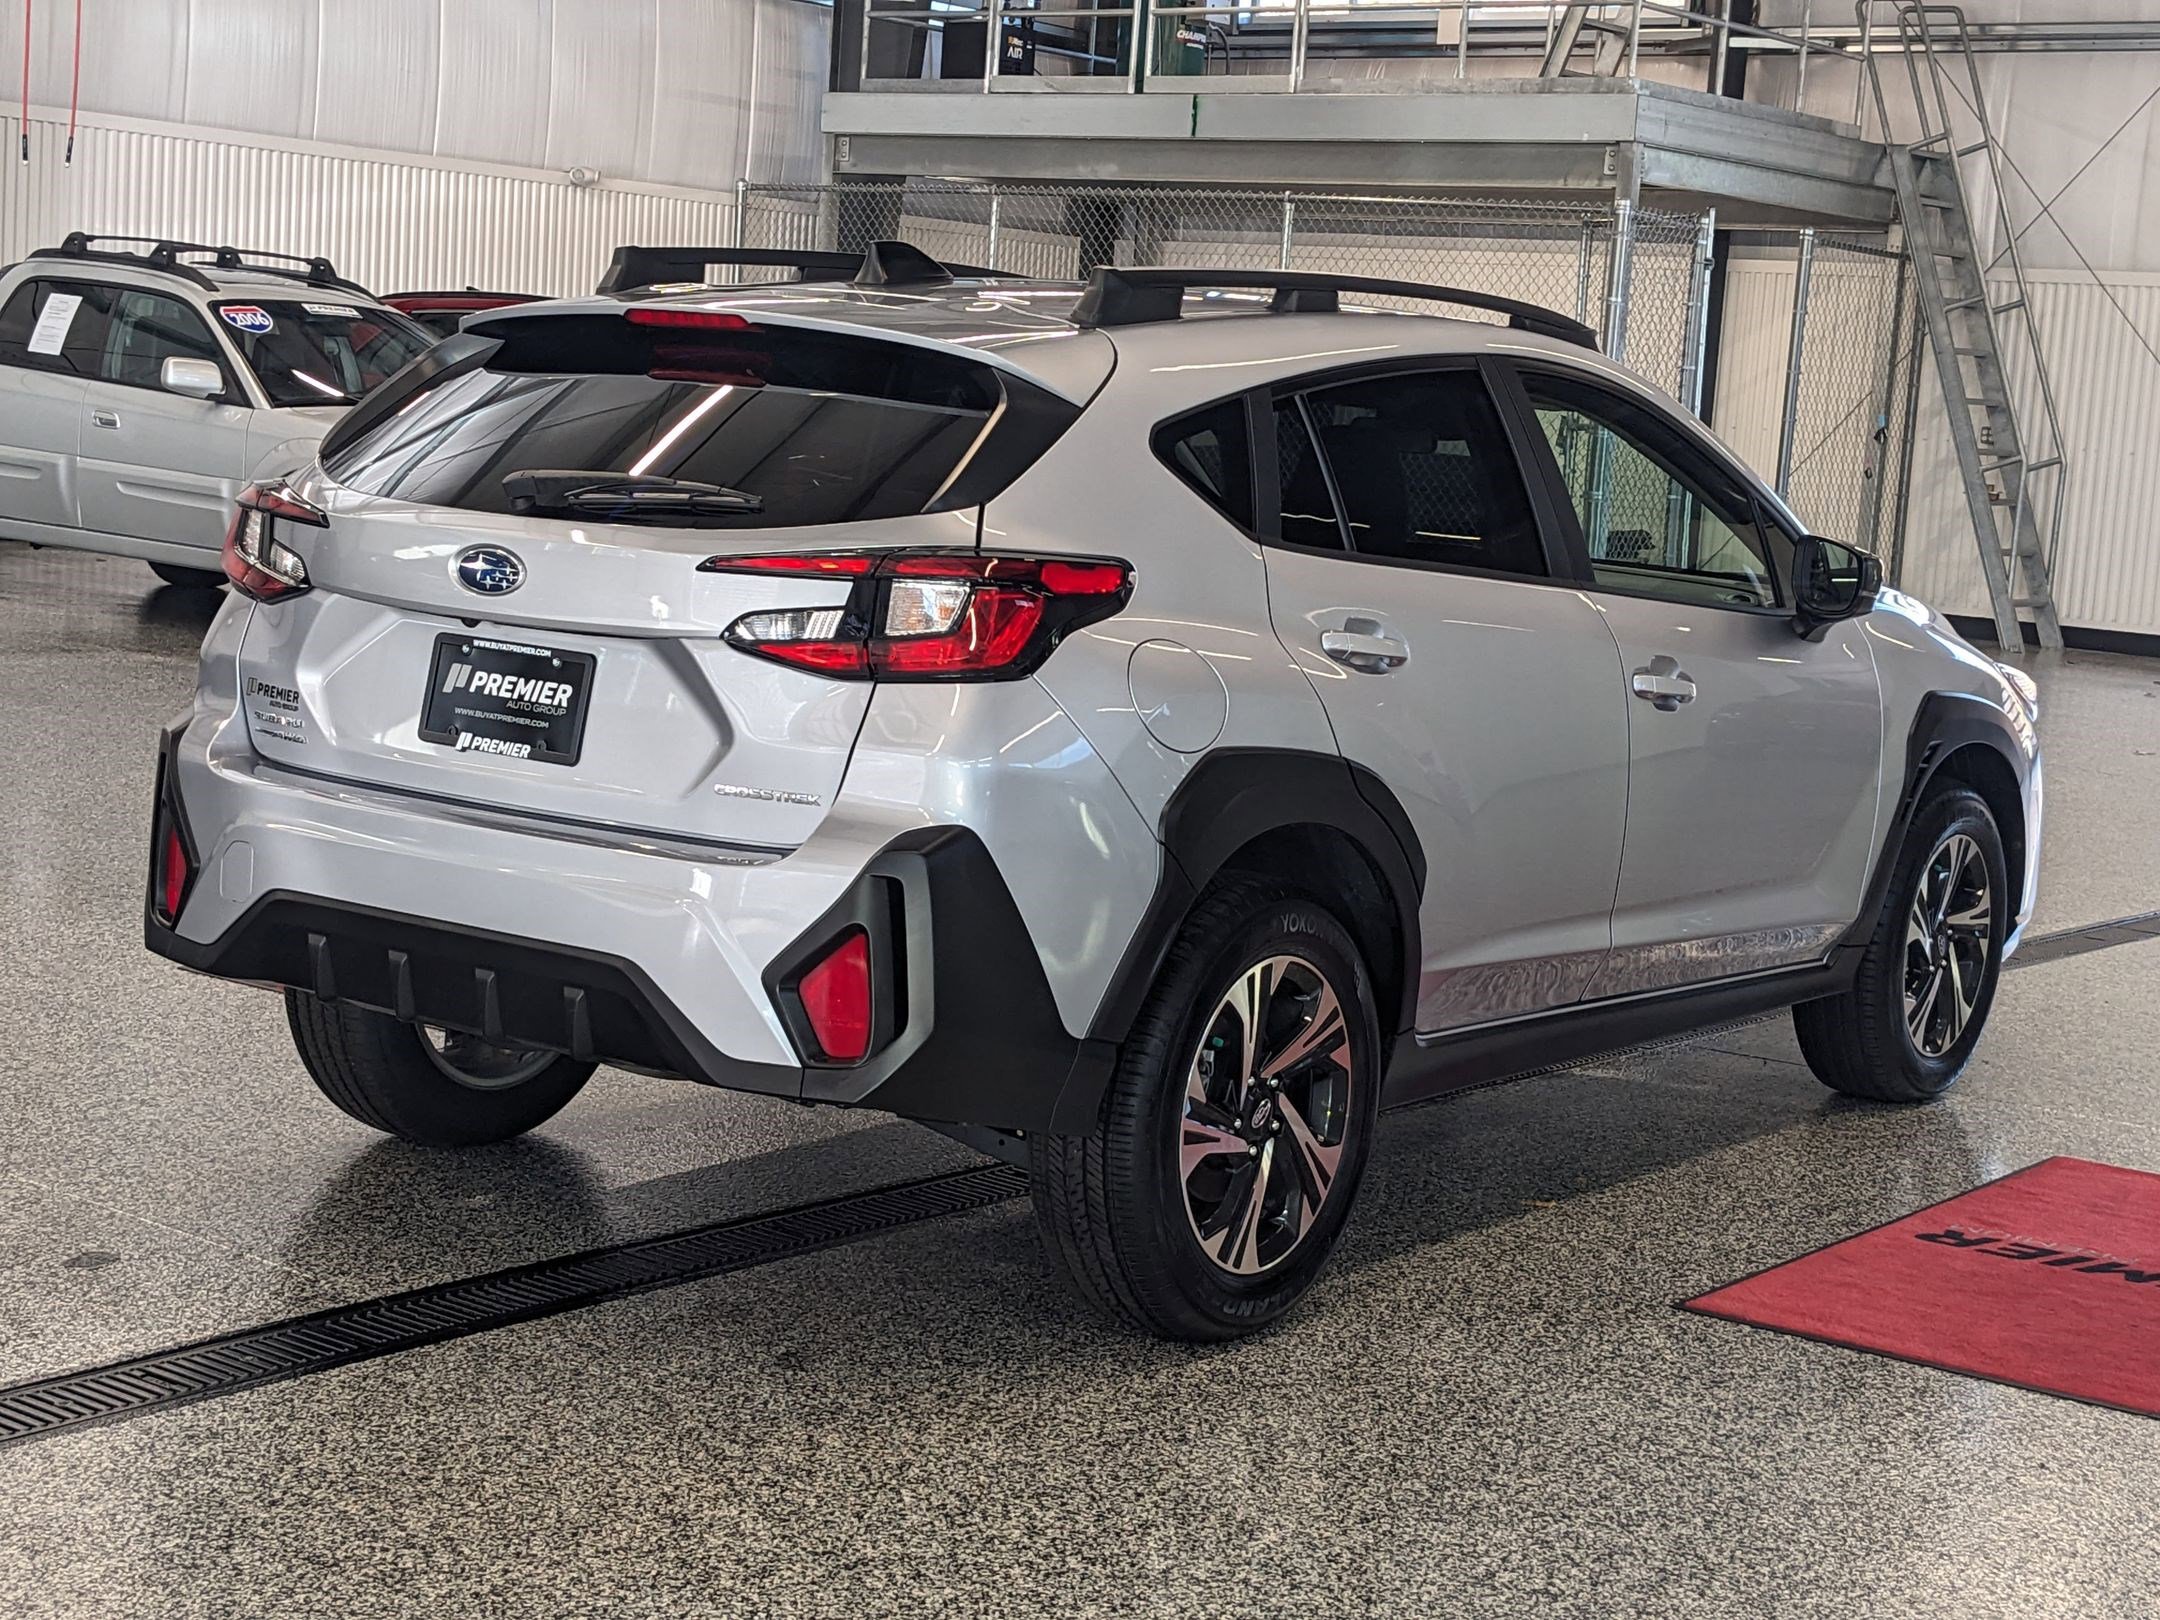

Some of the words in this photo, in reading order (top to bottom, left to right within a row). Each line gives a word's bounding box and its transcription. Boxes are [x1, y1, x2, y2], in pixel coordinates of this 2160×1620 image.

[1007, 46, 1023, 60] AIR
[230, 313, 270, 326] 2006
[257, 682, 300, 704] PREMIER
[469, 671, 573, 708] PREMIER
[505, 700, 532, 711] AUTO
[533, 703, 567, 716] GROUP
[471, 737, 531, 758] PREMIER
[714, 783, 821, 806] CROSSTREK
[1915, 1229, 2160, 1287] MIER
